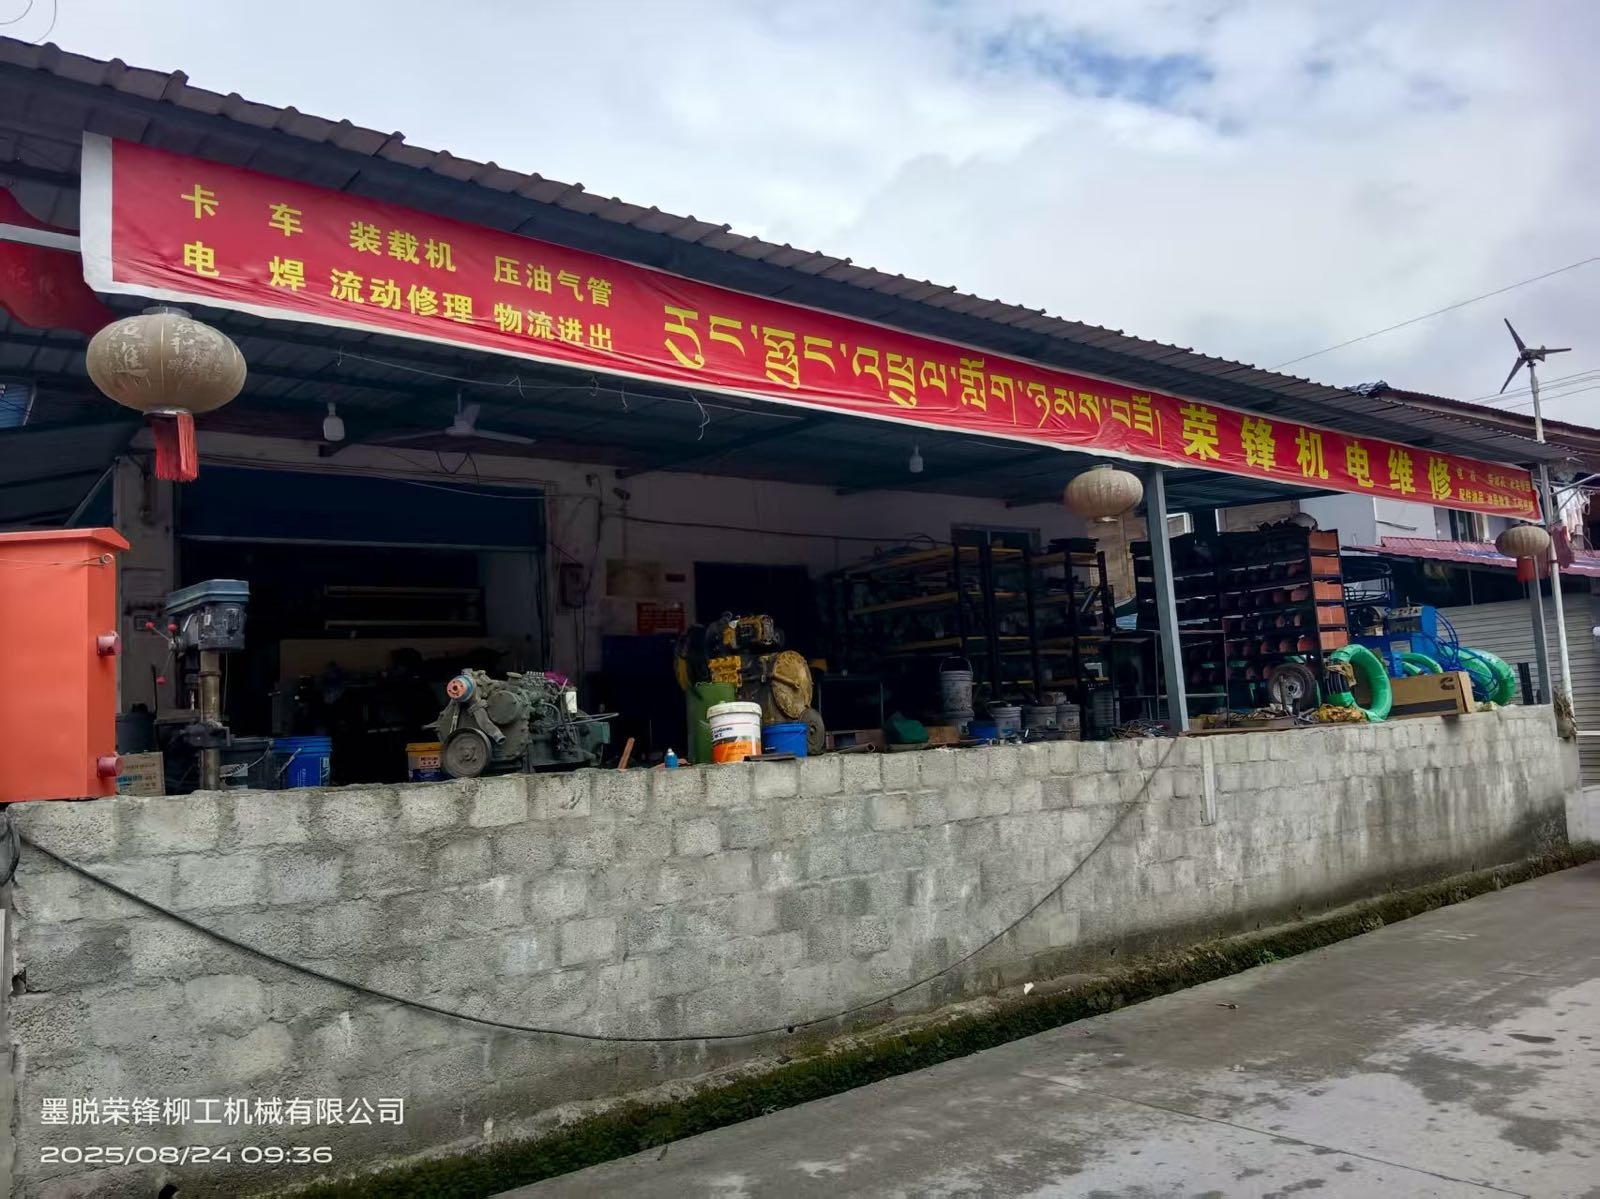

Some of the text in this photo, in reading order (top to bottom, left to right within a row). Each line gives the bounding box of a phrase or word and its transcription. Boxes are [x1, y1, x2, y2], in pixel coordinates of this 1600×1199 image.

[349, 221, 457, 274] 装载机
[493, 255, 613, 309] 压油气管
[330, 267, 473, 324] 流动修理
[493, 303, 613, 352] 物流进出
[1180, 402, 1453, 500] 荣锋机电维修
